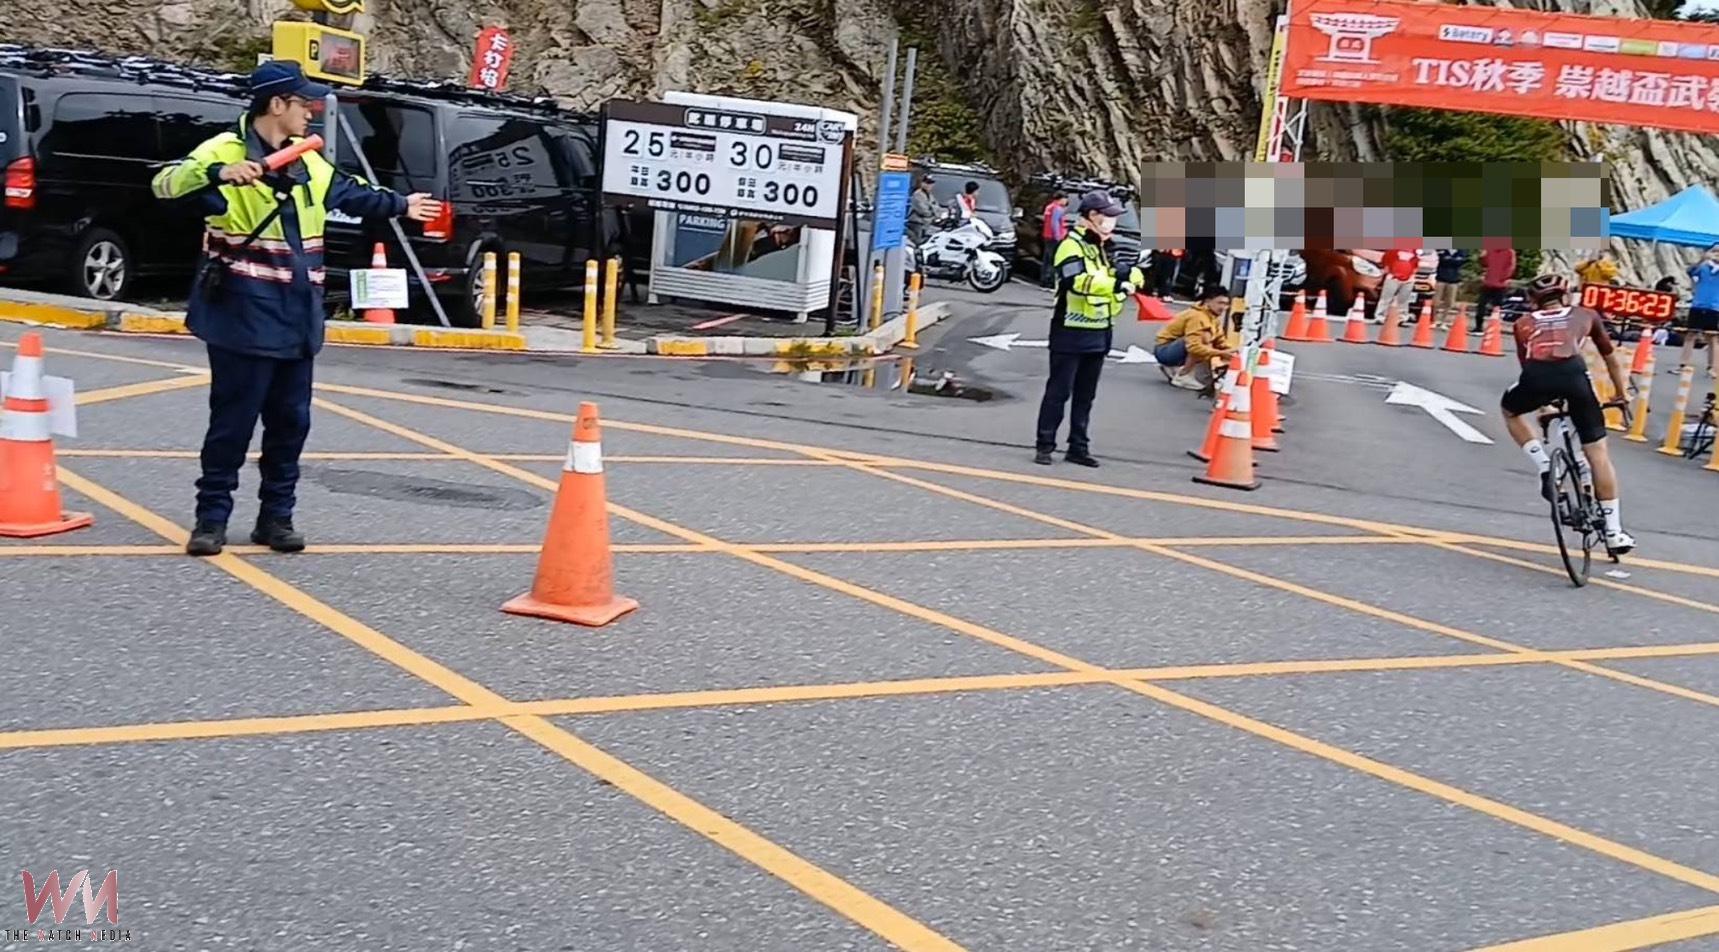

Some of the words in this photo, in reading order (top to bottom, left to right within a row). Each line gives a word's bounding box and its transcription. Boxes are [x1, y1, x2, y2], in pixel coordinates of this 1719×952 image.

[1411, 57, 1545, 95] TIS秋季
[623, 129, 665, 157] 25
[730, 141, 772, 169] 30
[656, 170, 710, 195] 300
[763, 181, 818, 207] 300
[679, 214, 726, 229] PARKING
[1583, 286, 1672, 317] 07:36:23
